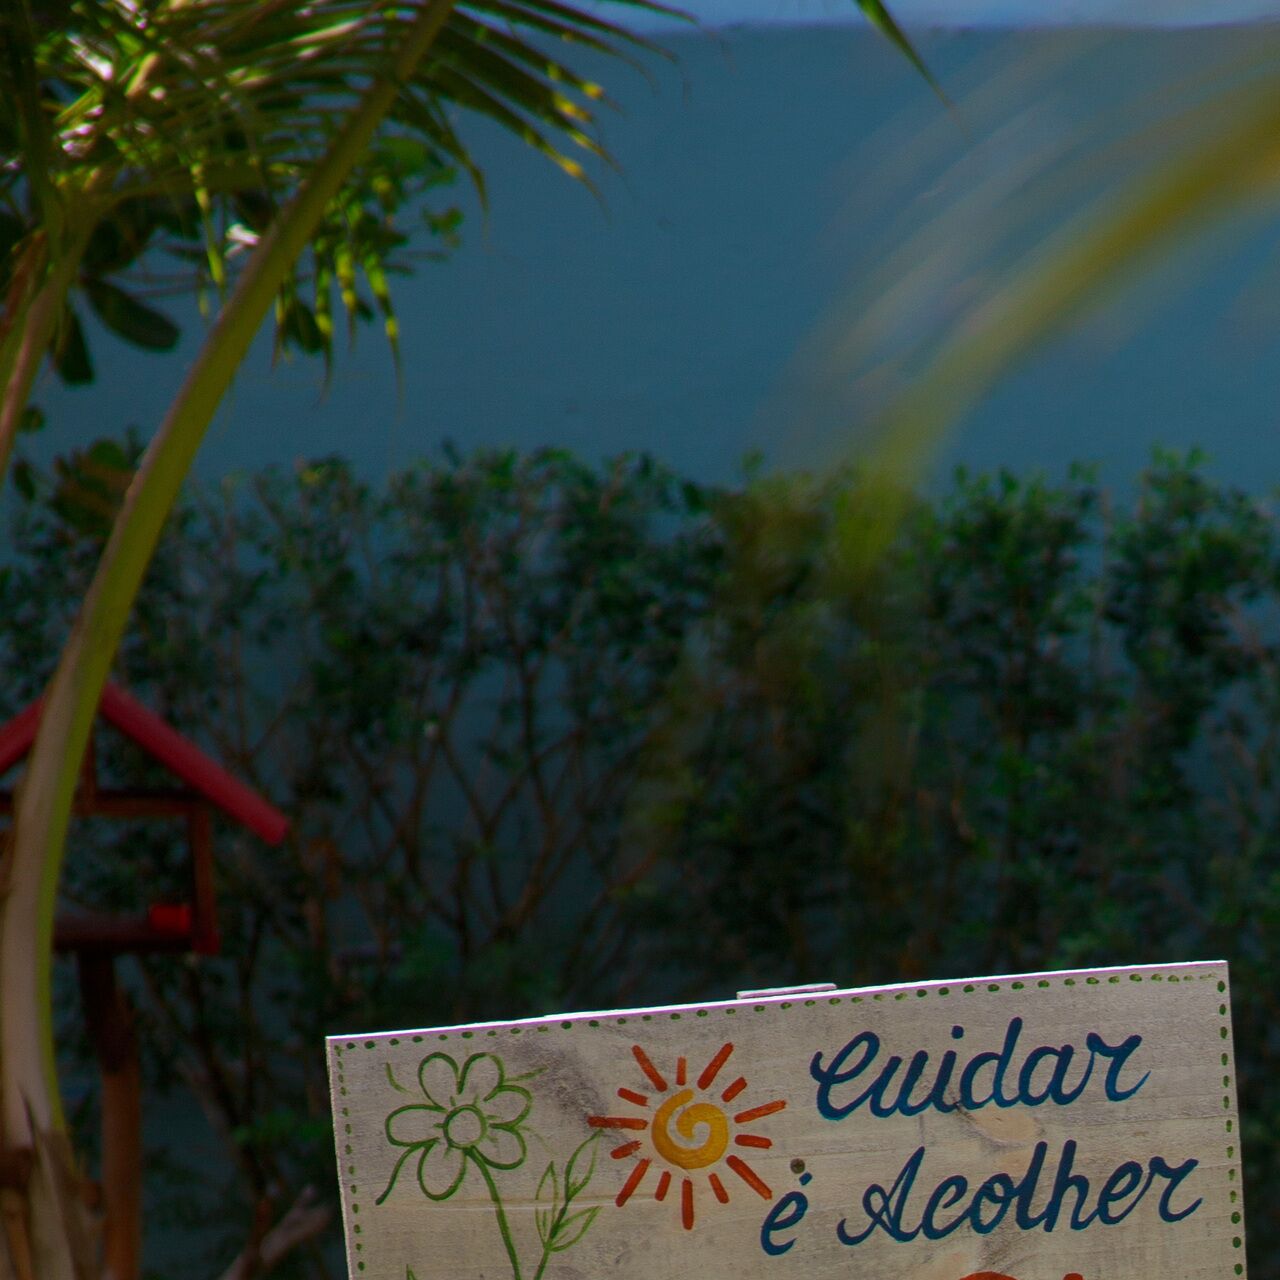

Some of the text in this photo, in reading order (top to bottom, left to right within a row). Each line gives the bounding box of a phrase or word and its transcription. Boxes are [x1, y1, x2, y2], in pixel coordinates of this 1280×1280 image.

[809, 1017, 1150, 1120] Cuidar
[759, 1139, 1202, 1255] é Acolher
